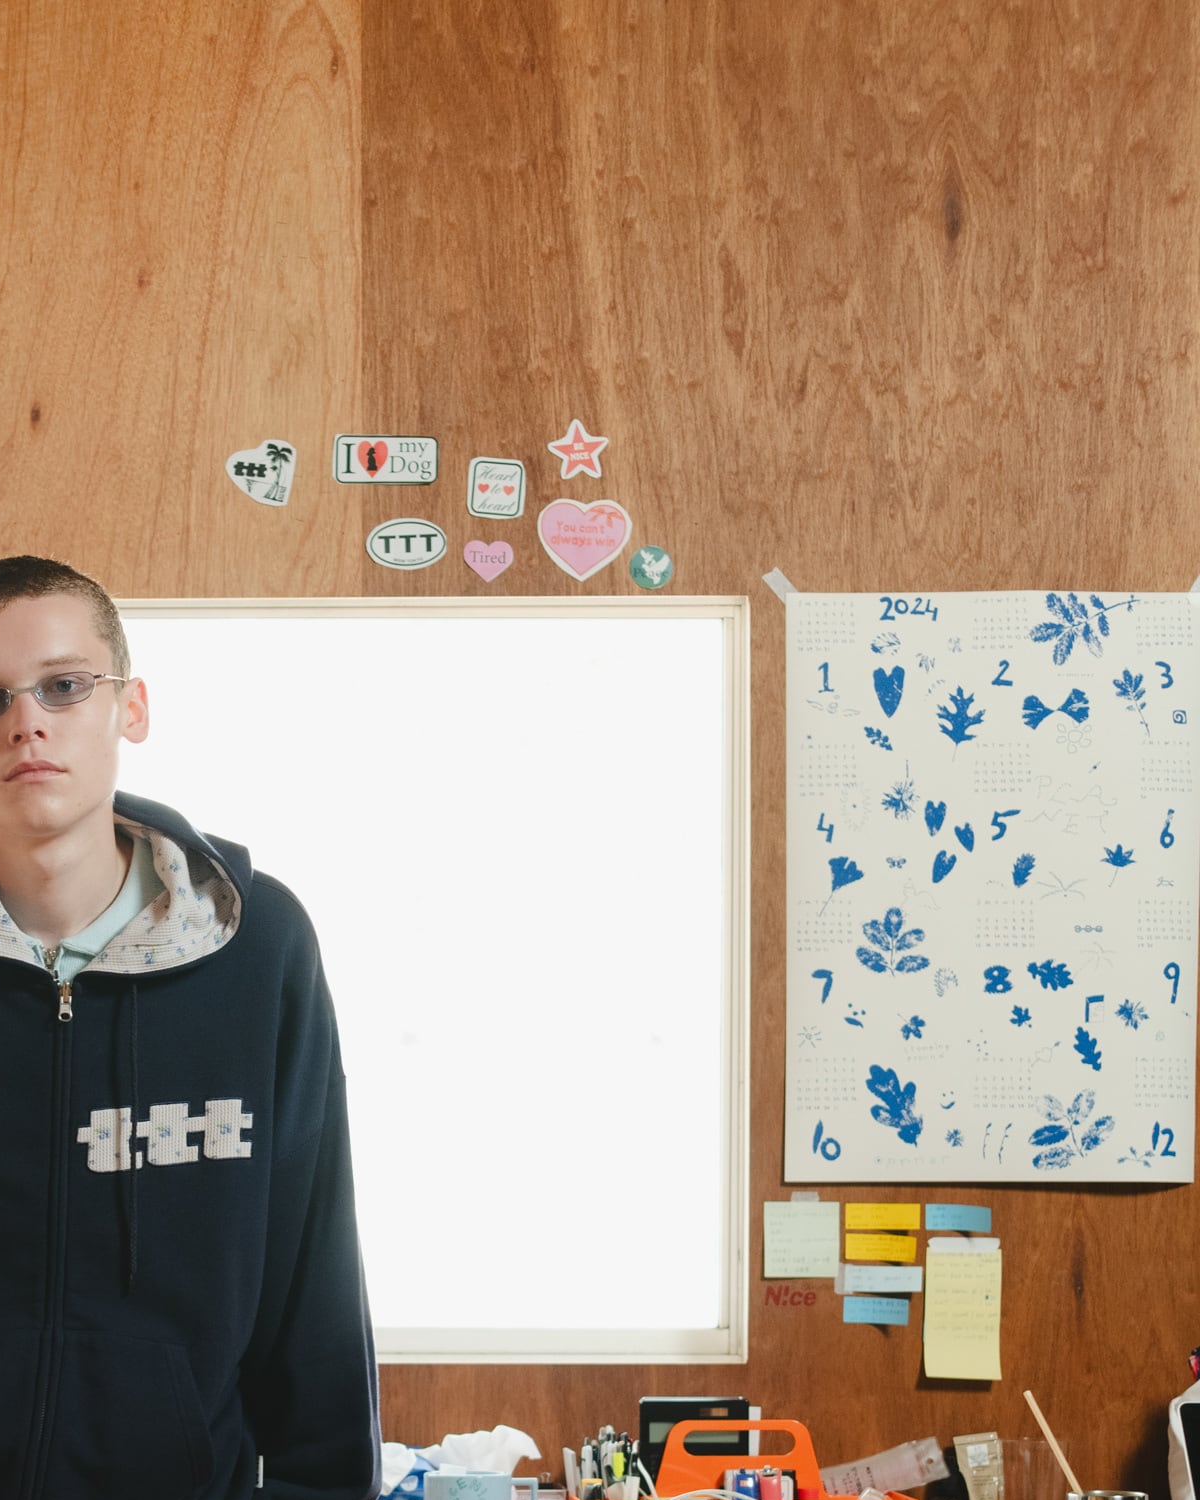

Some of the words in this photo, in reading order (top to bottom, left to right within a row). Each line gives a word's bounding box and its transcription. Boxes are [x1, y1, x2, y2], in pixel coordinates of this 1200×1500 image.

[341, 443, 356, 474] I
[399, 441, 429, 458] my
[569, 452, 590, 462] NICE
[233, 461, 267, 478] ttt
[389, 455, 432, 480] Dog
[479, 464, 518, 481] Heart
[490, 483, 502, 495] to
[476, 496, 516, 512] heart
[556, 520, 576, 532] You
[378, 534, 437, 554] TTT
[550, 535, 592, 547] always
[595, 537, 615, 547] win
[469, 550, 506, 564] Tired
[633, 567, 669, 579] Peace
[879, 596, 938, 621] 2024
[818, 662, 834, 693] 1
[991, 660, 1013, 687] 2
[1155, 661, 1174, 689] 3
[816, 813, 834, 843] 4
[991, 809, 1020, 841] 5
[1159, 809, 1175, 849] 6
[811, 969, 834, 1004] 7
[983, 965, 1013, 994] 8
[1163, 962, 1180, 1004] 9
[812, 1120, 841, 1161] 10
[1151, 1121, 1177, 1158] 12
